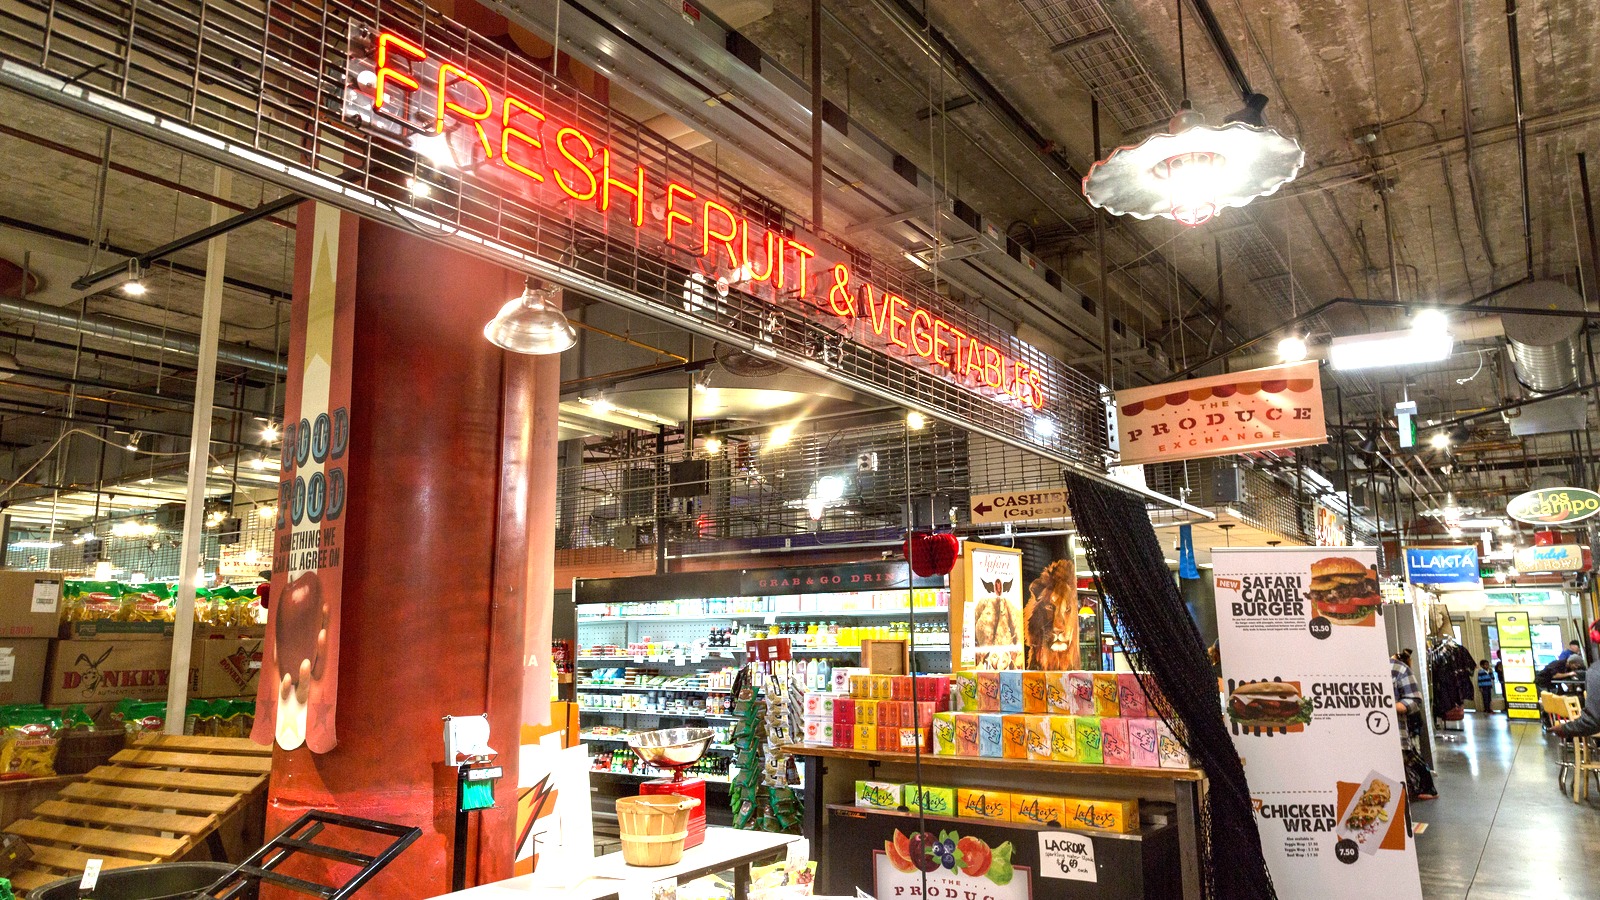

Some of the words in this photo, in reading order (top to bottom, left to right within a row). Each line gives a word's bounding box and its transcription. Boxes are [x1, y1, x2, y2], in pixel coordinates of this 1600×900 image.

[374, 31, 646, 228] FRESH
[665, 182, 816, 300] FRUIT
[828, 262, 857, 320] &
[864, 282, 1044, 410] VEGETABLES
[1199, 400, 1230, 410] THE
[1127, 406, 1312, 443] PRODUCE
[282, 405, 349, 473] GOOD
[1158, 430, 1282, 453] EXCHANGE
[277, 466, 346, 531] FOOD
[1537, 491, 1570, 504] Los
[1003, 504, 1067, 519] (Cajero)
[279, 529, 321, 554] SOMETHING
[323, 526, 337, 547] WE
[298, 549, 327, 571] AGREE
[328, 547, 341, 568] ON
[1410, 553, 1475, 569] LLAKTA
[759, 578, 801, 588] GRAB
[806, 578, 815, 586] &
[820, 575, 842, 585] GO
[851, 572, 897, 583] DRIN
[1219, 579, 1239, 590] NEW
[1242, 576, 1303, 589] SAFARI
[1241, 588, 1304, 603] CAMEL
[1231, 602, 1305, 617] BURGER
[1311, 682, 1384, 696] CHICKEN
[1313, 695, 1393, 709] SANDWIC
[1374, 717, 1381, 728] 7
[1260, 804, 1335, 819] CHICKEN
[1282, 818, 1337, 832] WRAP
[1044, 839, 1088, 856] LACROIX
[941, 878, 961, 887] THE
